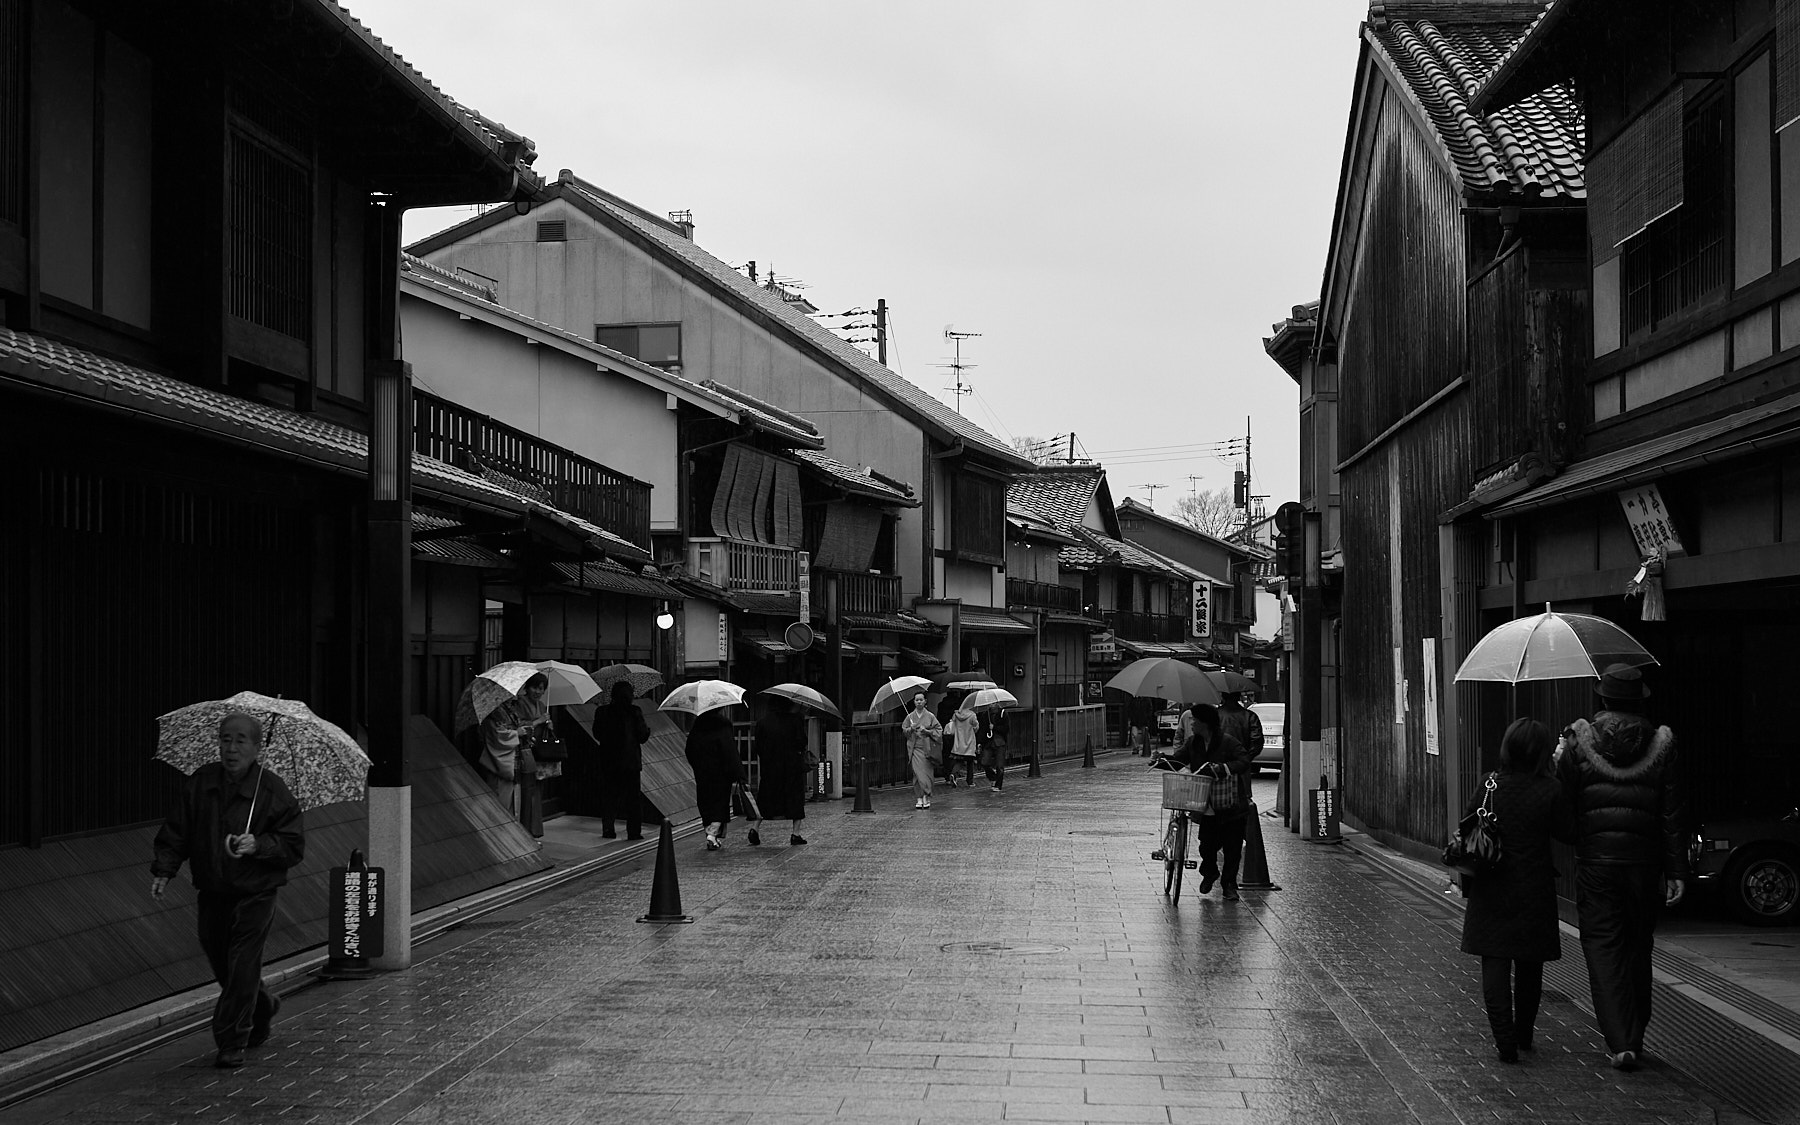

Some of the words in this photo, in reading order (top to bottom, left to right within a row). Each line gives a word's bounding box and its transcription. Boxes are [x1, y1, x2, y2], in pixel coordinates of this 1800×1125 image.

[367, 872, 378, 918] 車が通ります
